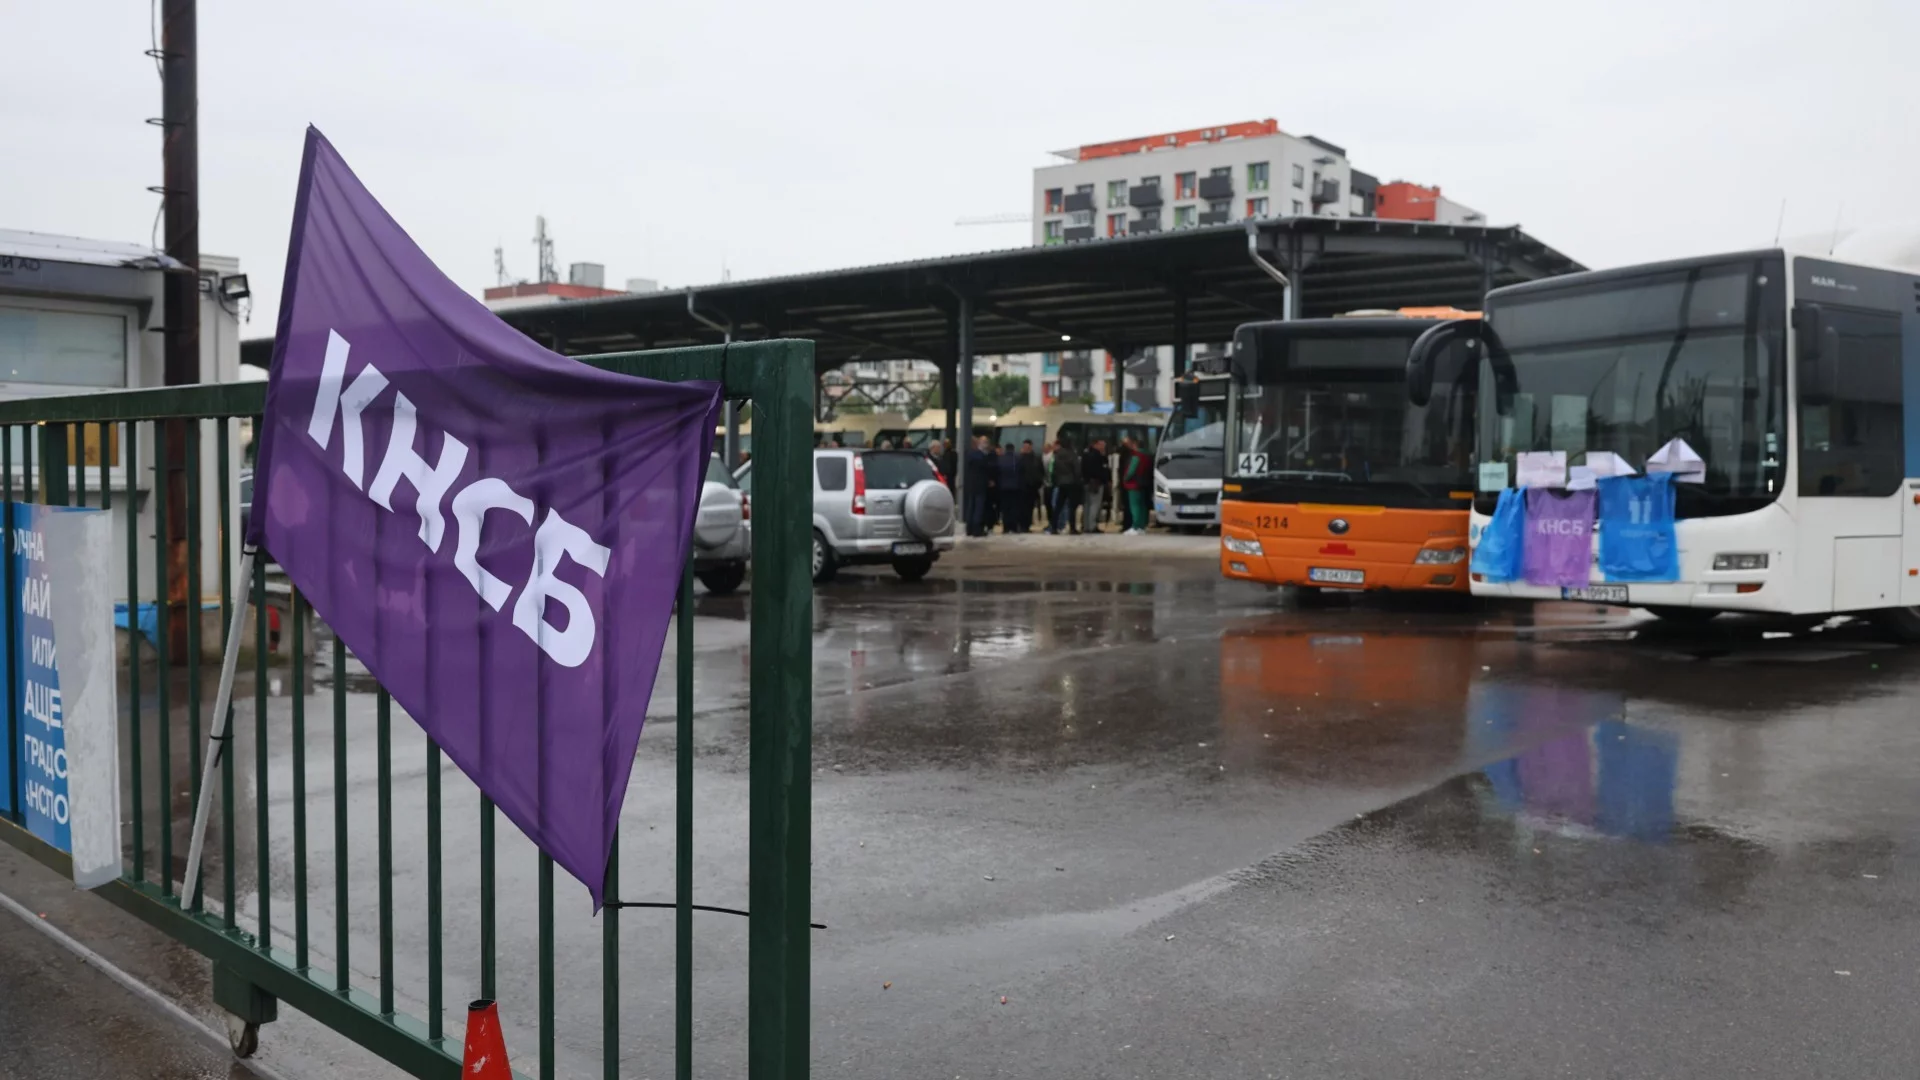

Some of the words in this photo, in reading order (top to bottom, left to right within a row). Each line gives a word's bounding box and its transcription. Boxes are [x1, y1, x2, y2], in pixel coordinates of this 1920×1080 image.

[1811, 275, 1836, 287] MAN
[1241, 454, 1266, 474] 42
[307, 327, 612, 668] КНСБ
[1256, 515, 1289, 529] 1214
[1537, 519, 1585, 536] КНСБ
[23, 679, 64, 732] АЩЕ
